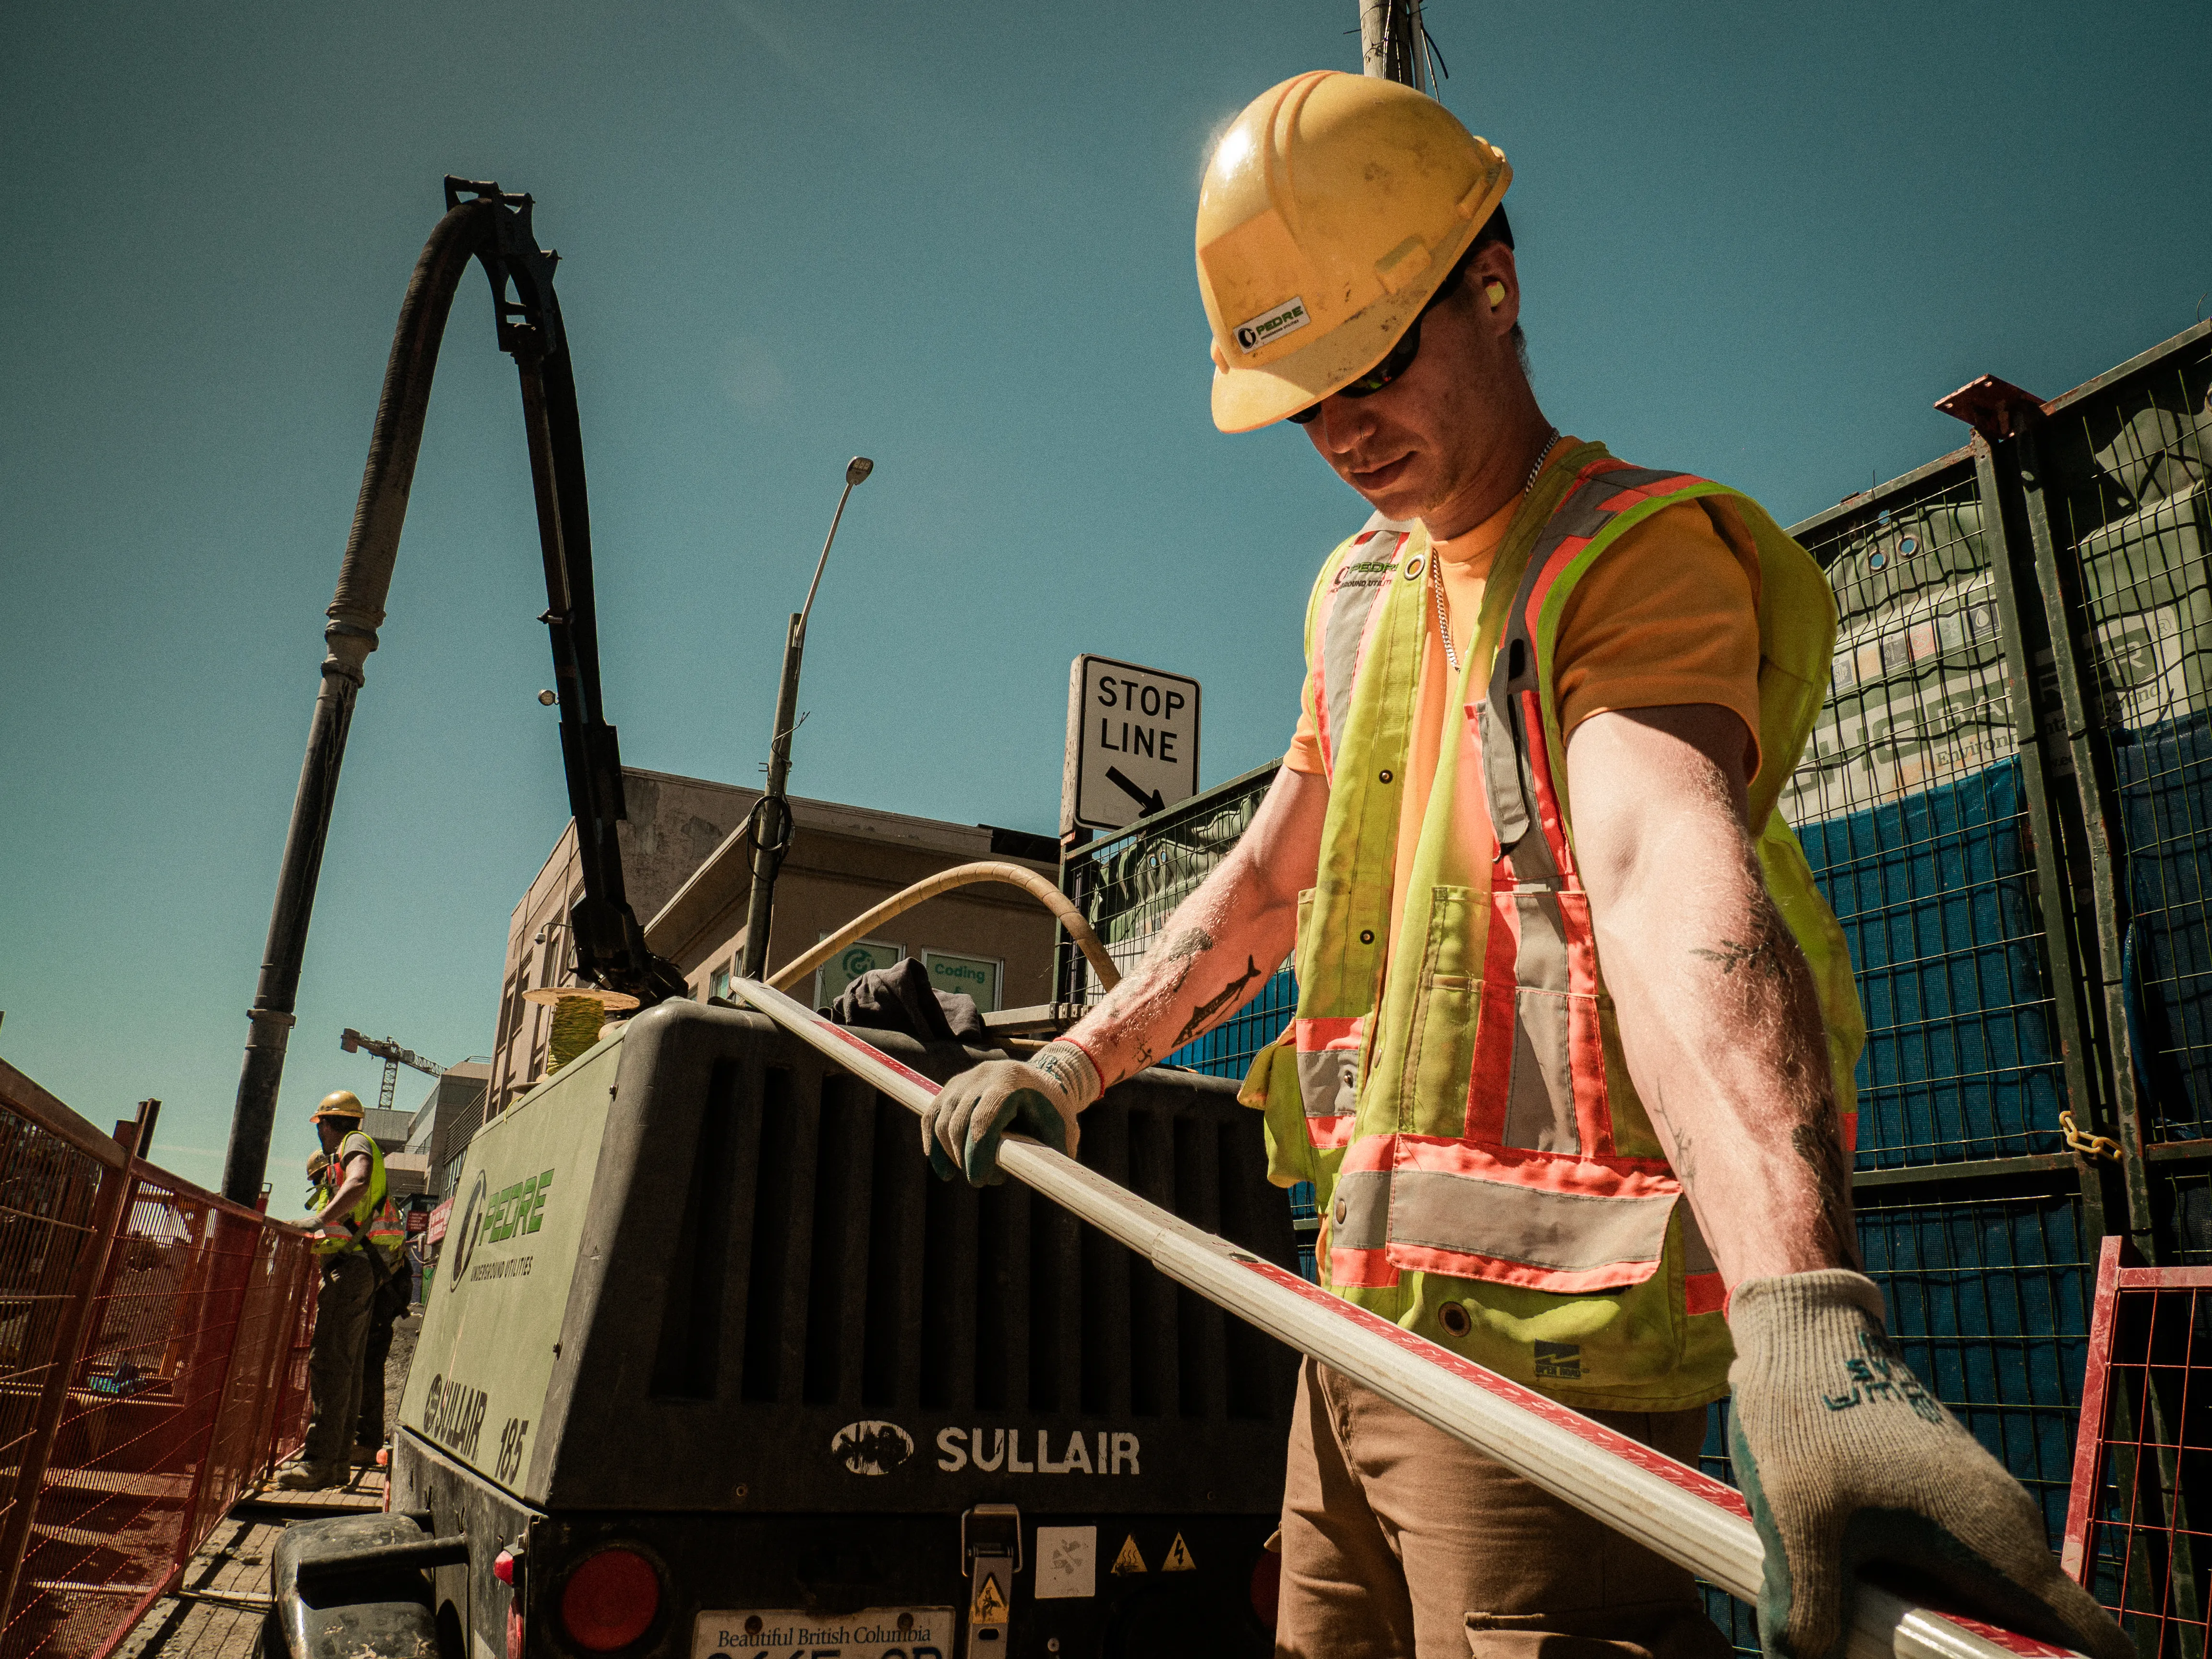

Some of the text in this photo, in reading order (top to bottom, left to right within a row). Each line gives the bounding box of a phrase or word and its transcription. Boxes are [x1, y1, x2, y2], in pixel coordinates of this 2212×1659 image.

[1256, 306, 1303, 335] PEDRE
[1350, 561, 1399, 574] PEDR
[1097, 676, 1185, 720] STOP
[1101, 718, 1177, 763] LINE
[935, 963, 985, 984] Coding
[479, 1168, 555, 1246] PEDRE
[470, 1255, 533, 1282] UNDERGROUND UTILITIES
[433, 1379, 529, 1485] SULLAIR 185
[937, 1427, 1140, 1475] SULLAIR
[718, 1625, 931, 1647] Beautiful British Columbia
